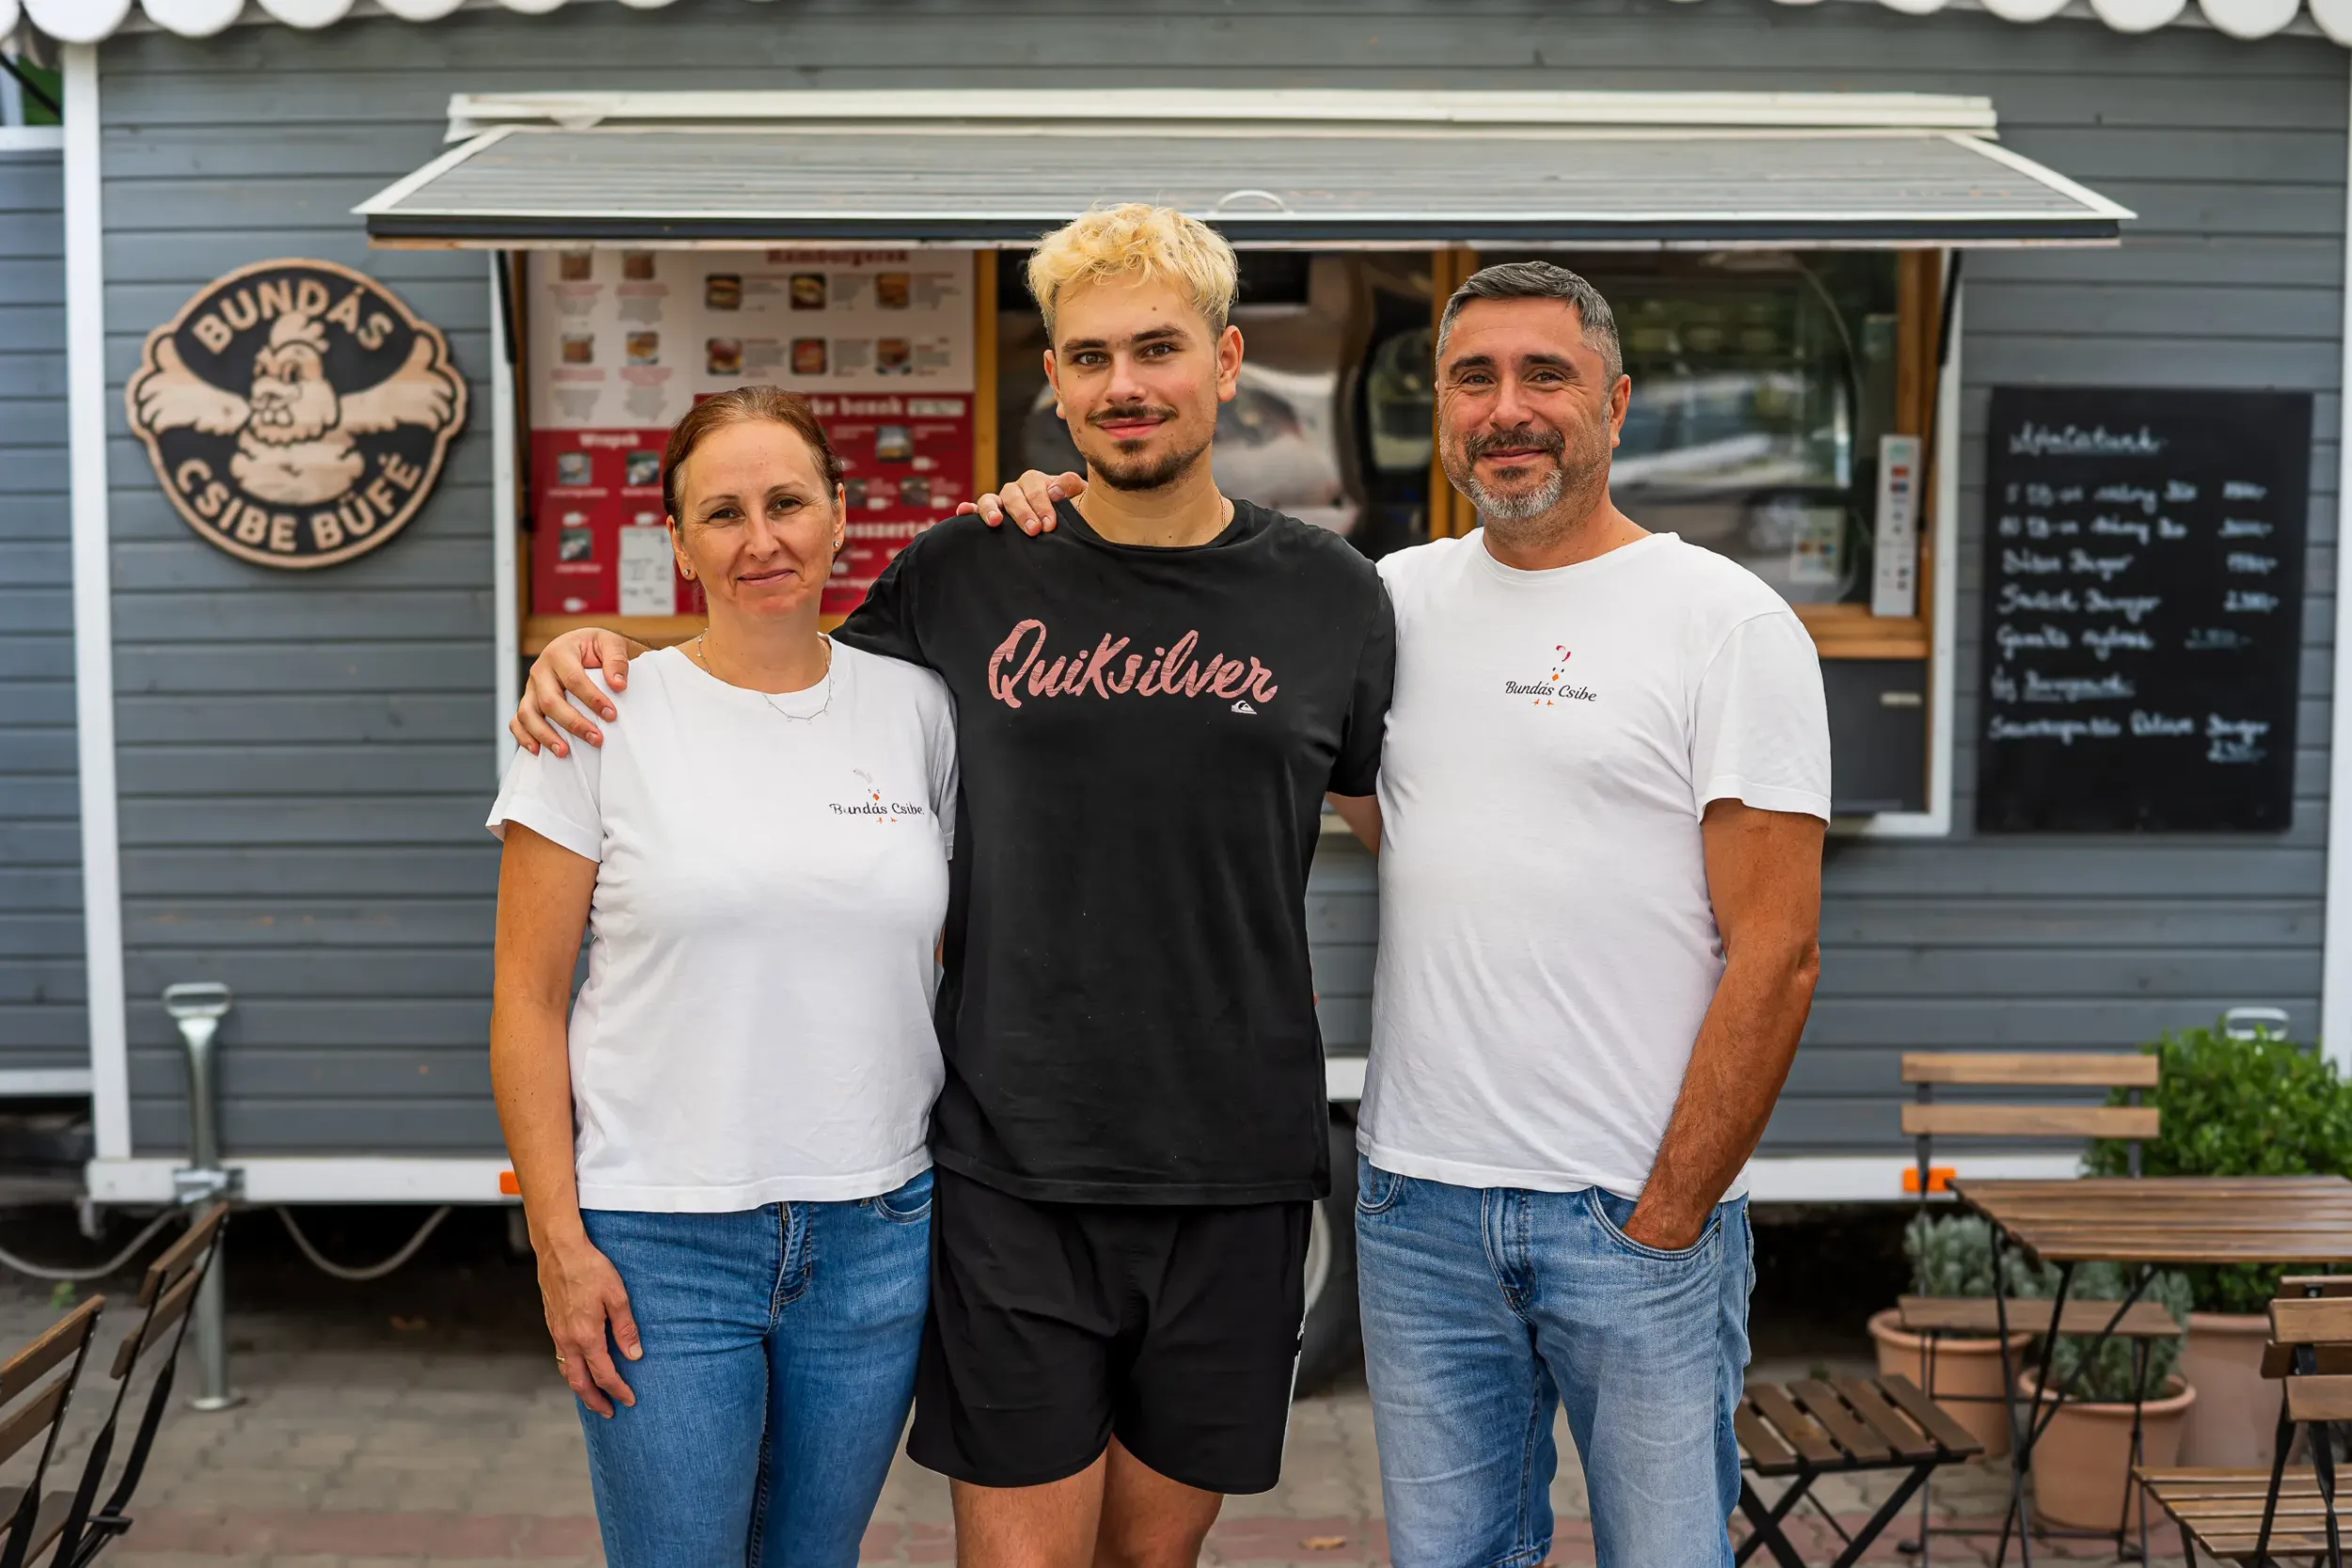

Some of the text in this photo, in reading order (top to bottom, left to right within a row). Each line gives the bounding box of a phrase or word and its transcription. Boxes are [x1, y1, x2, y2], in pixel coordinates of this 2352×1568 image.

[192, 278, 395, 355] BUNDÁS
[176, 452, 422, 553] CSIBE BÜFÉ
[1505, 681, 1597, 702] Bundás Csibe
[891, 801, 924, 815] Csibe
